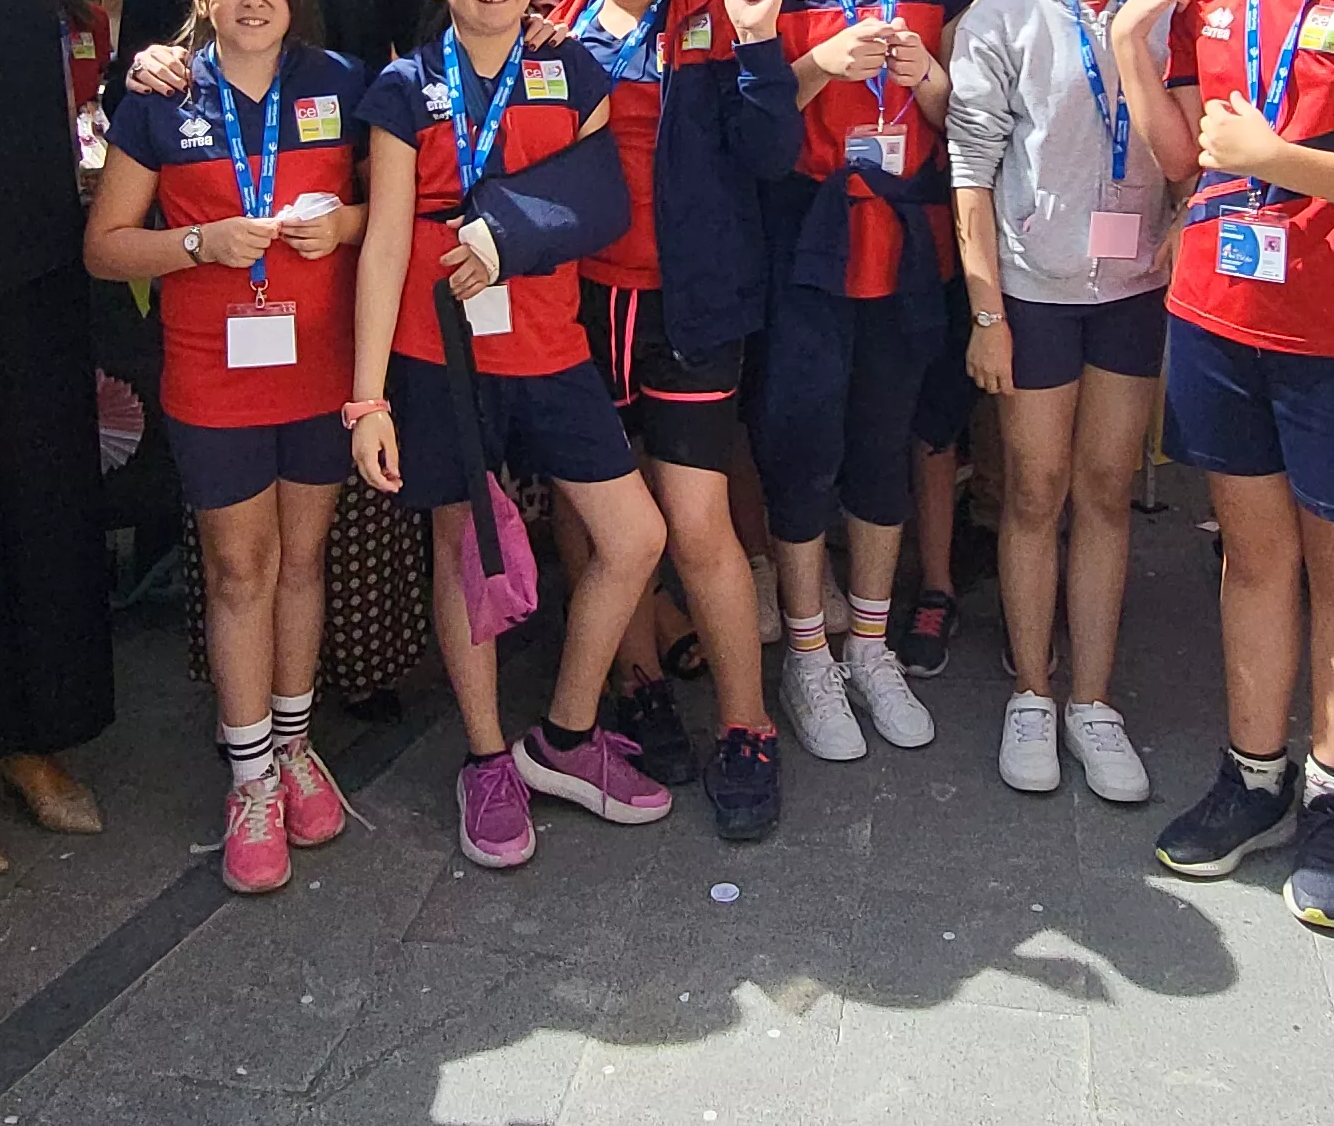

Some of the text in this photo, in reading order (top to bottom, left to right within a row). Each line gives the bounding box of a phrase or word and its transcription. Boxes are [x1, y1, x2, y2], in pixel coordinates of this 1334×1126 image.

[1201, 25, 1231, 41] errea
[524, 68, 543, 78] ce
[298, 107, 317, 119] ce
[180, 135, 213, 149] errea
